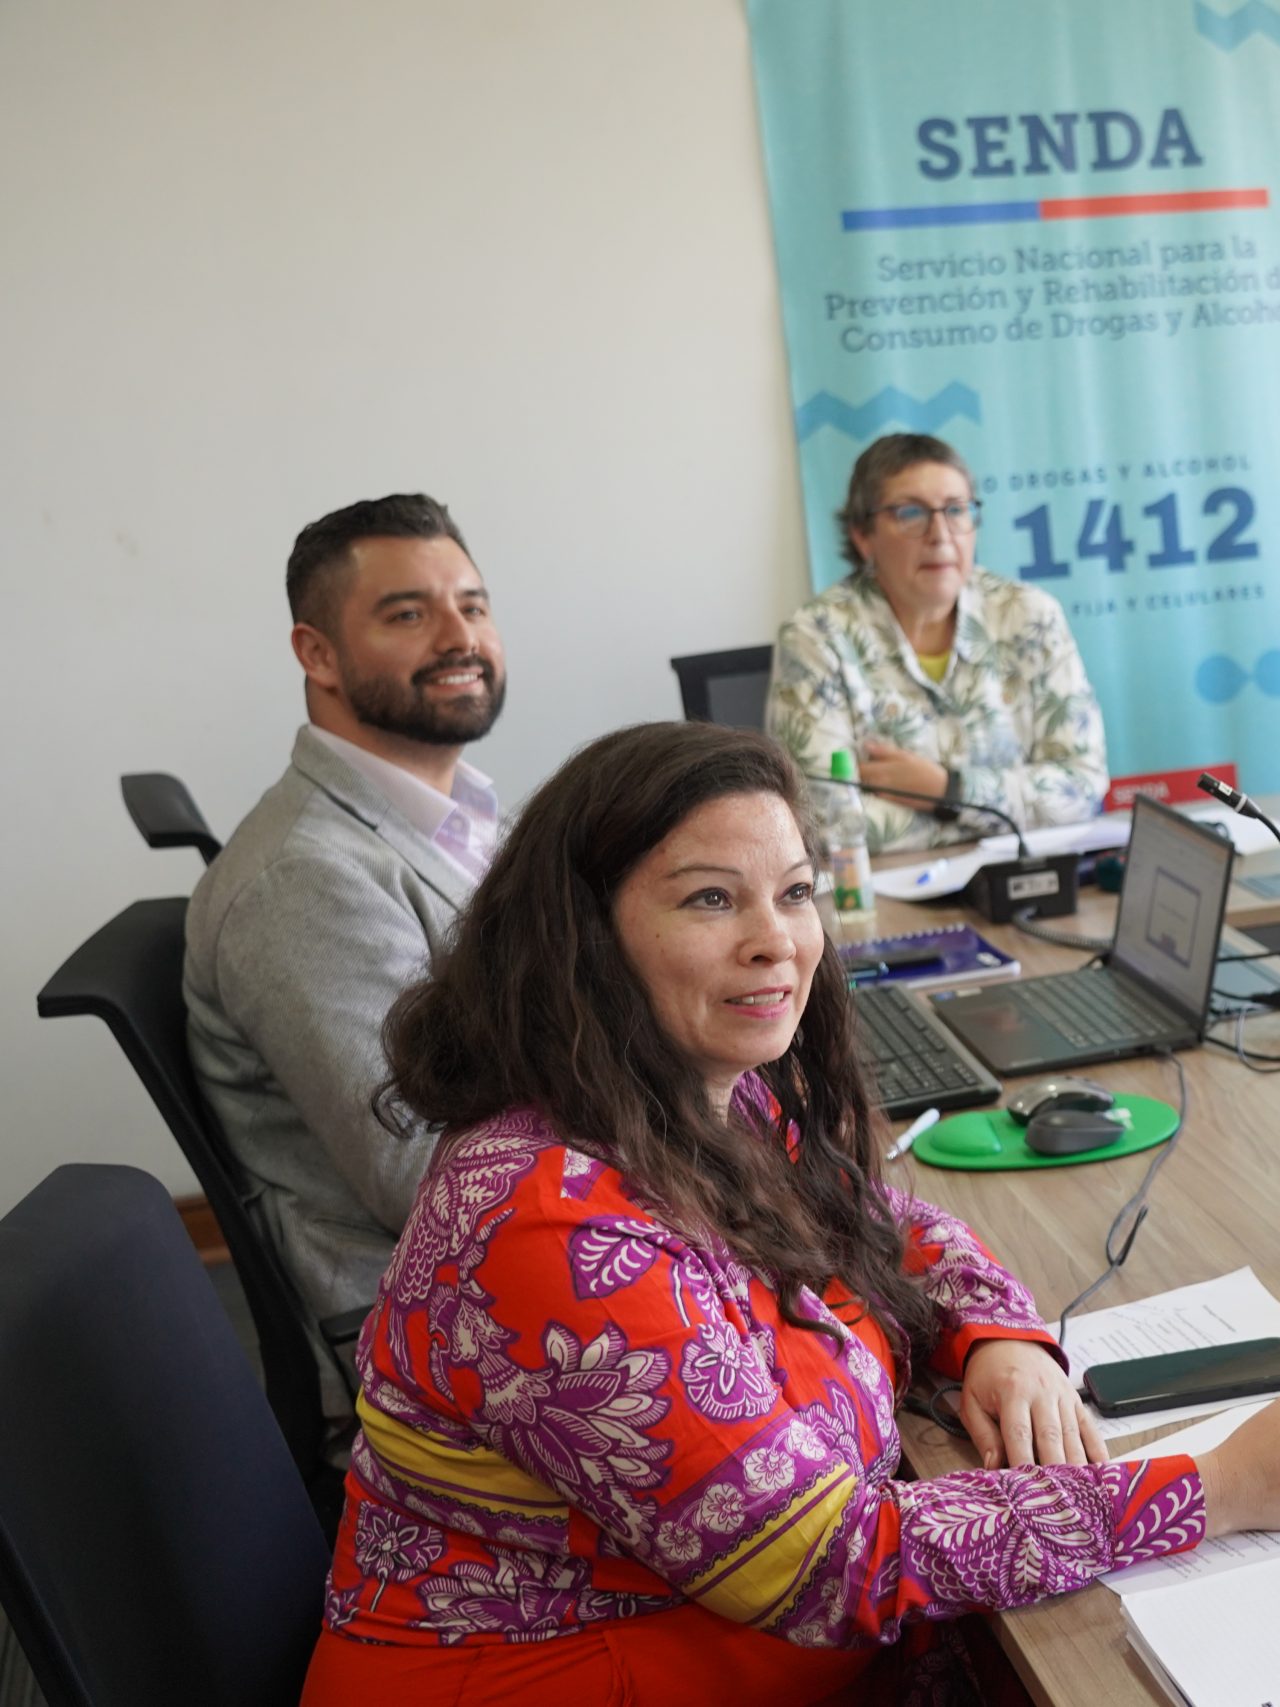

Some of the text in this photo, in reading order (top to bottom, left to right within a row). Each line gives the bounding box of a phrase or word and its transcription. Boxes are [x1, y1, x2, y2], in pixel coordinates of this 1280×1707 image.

[917, 107, 1204, 182] SENDA
[877, 233, 1257, 283] Servicio Nacional para la
[825, 284, 1008, 321] Prevención
[1014, 286, 1034, 316] y
[1043, 267, 1260, 306] Rehabilitación
[841, 323, 998, 353] Consumo
[1005, 313, 1042, 342] de
[1051, 311, 1159, 341] Drogas
[1165, 311, 1183, 338] y
[1008, 466, 1107, 492] DROGAS
[1118, 462, 1131, 481] Y
[1144, 453, 1252, 478] ALCOHOL
[1012, 486, 1260, 581] 1412
[1127, 595, 1138, 612] Y
[1146, 584, 1265, 611] CELULARES
